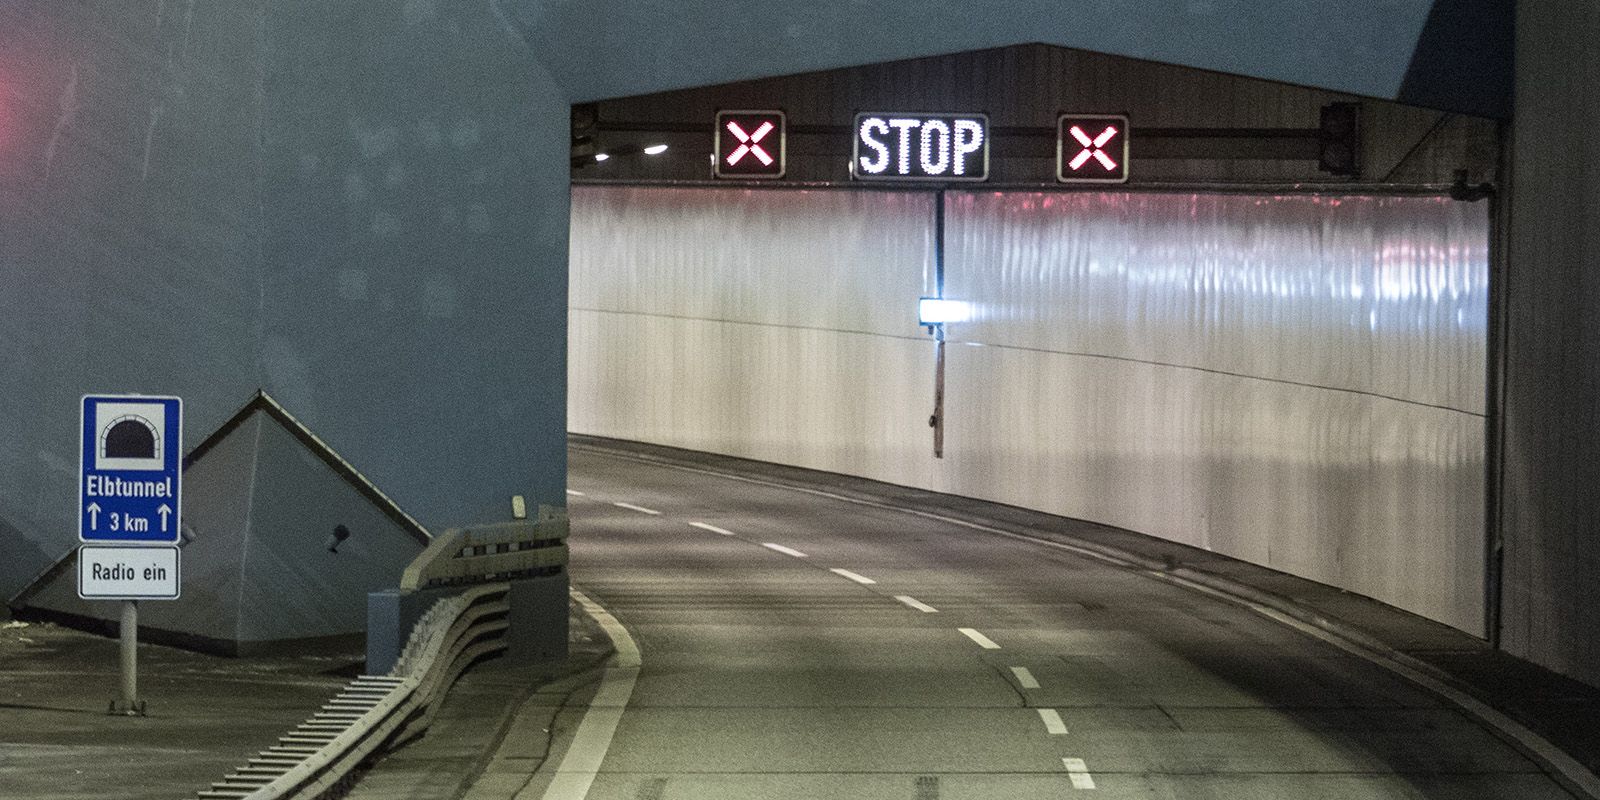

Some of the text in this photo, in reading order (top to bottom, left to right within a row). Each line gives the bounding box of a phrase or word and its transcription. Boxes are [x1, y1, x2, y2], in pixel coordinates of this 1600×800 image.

[859, 117, 984, 175] STOP
[86, 474, 173, 498] Elbtunnel
[109, 512, 149, 533] 3 km
[92, 562, 167, 581] Radio ein
